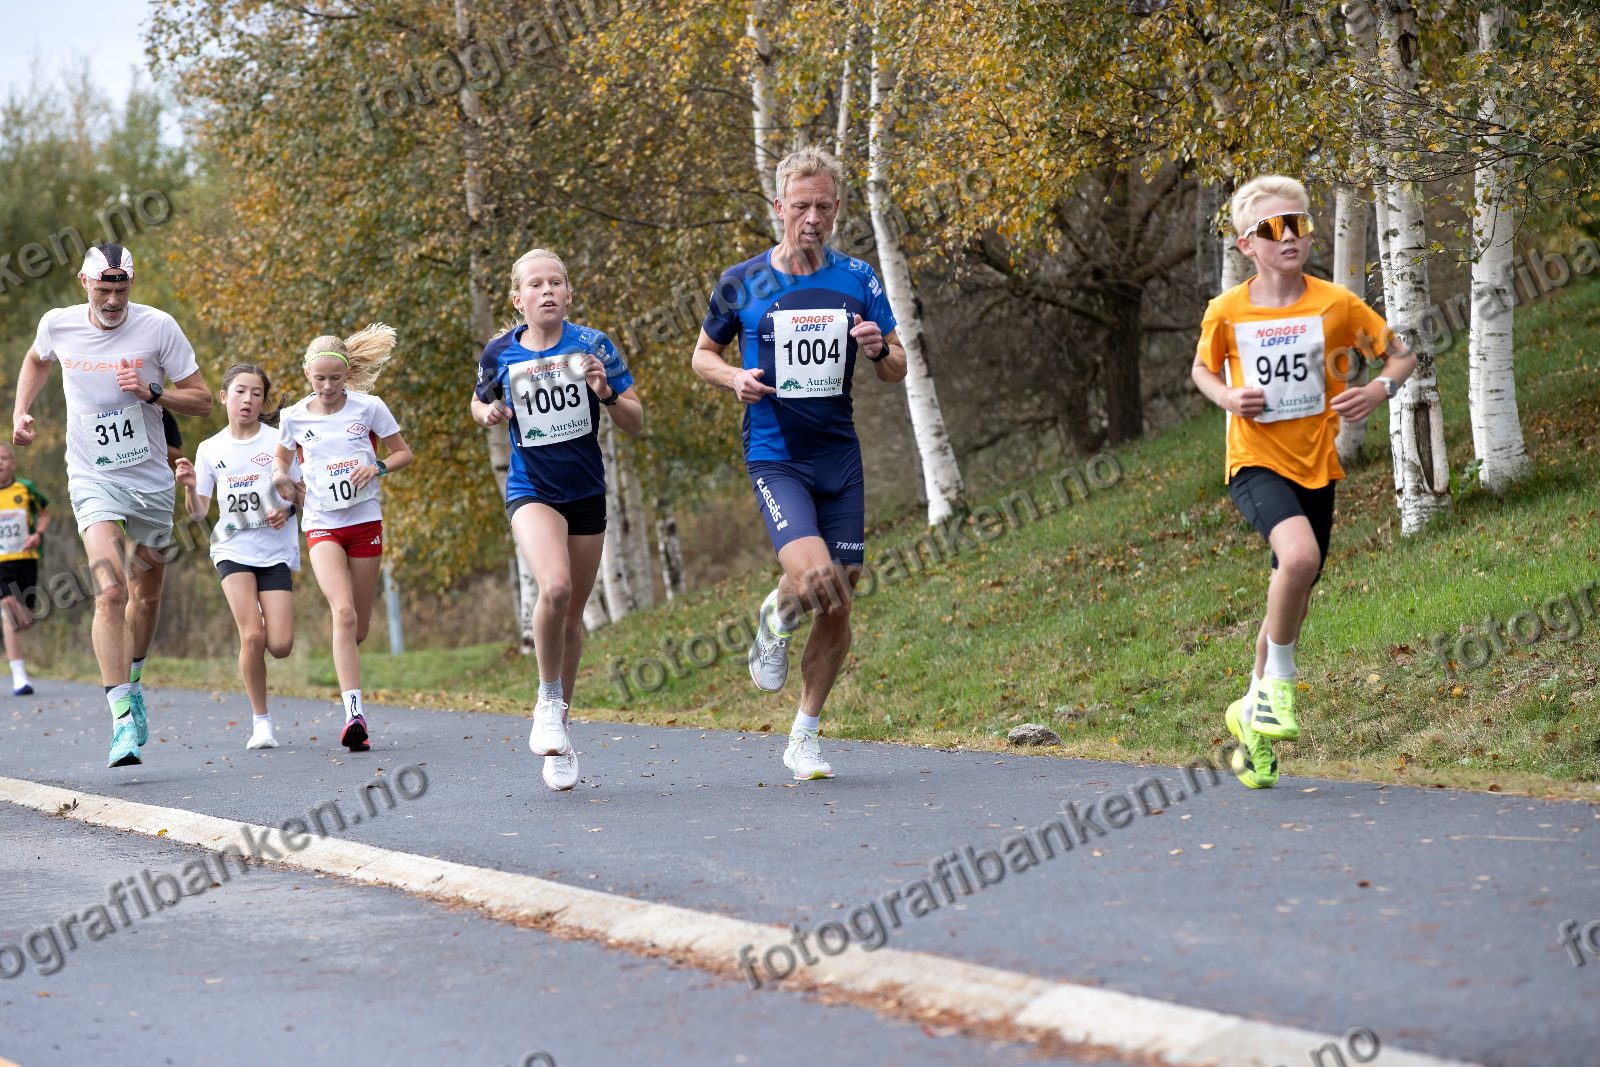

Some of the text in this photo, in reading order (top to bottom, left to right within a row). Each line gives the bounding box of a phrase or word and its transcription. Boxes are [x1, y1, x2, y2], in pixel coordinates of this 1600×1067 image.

[791, 315, 834, 324] NORGES
[795, 323, 827, 332] LØPET
[1256, 325, 1307, 338] NORGES
[1261, 335, 1299, 347] LØPET
[783, 338, 840, 365] 1004
[527, 361, 569, 375] NORGES
[1256, 353, 1308, 385] 945
[530, 370, 563, 382] LØPET
[806, 376, 842, 387] Aurskog
[520, 383, 581, 416] 1003
[549, 417, 589, 433] Aurskog
[95, 418, 135, 446] 314
[115, 446, 149, 460] Aurskog
[326, 459, 359, 471] NORGES
[229, 480, 255, 489] LØPET
[227, 491, 261, 513] 259
